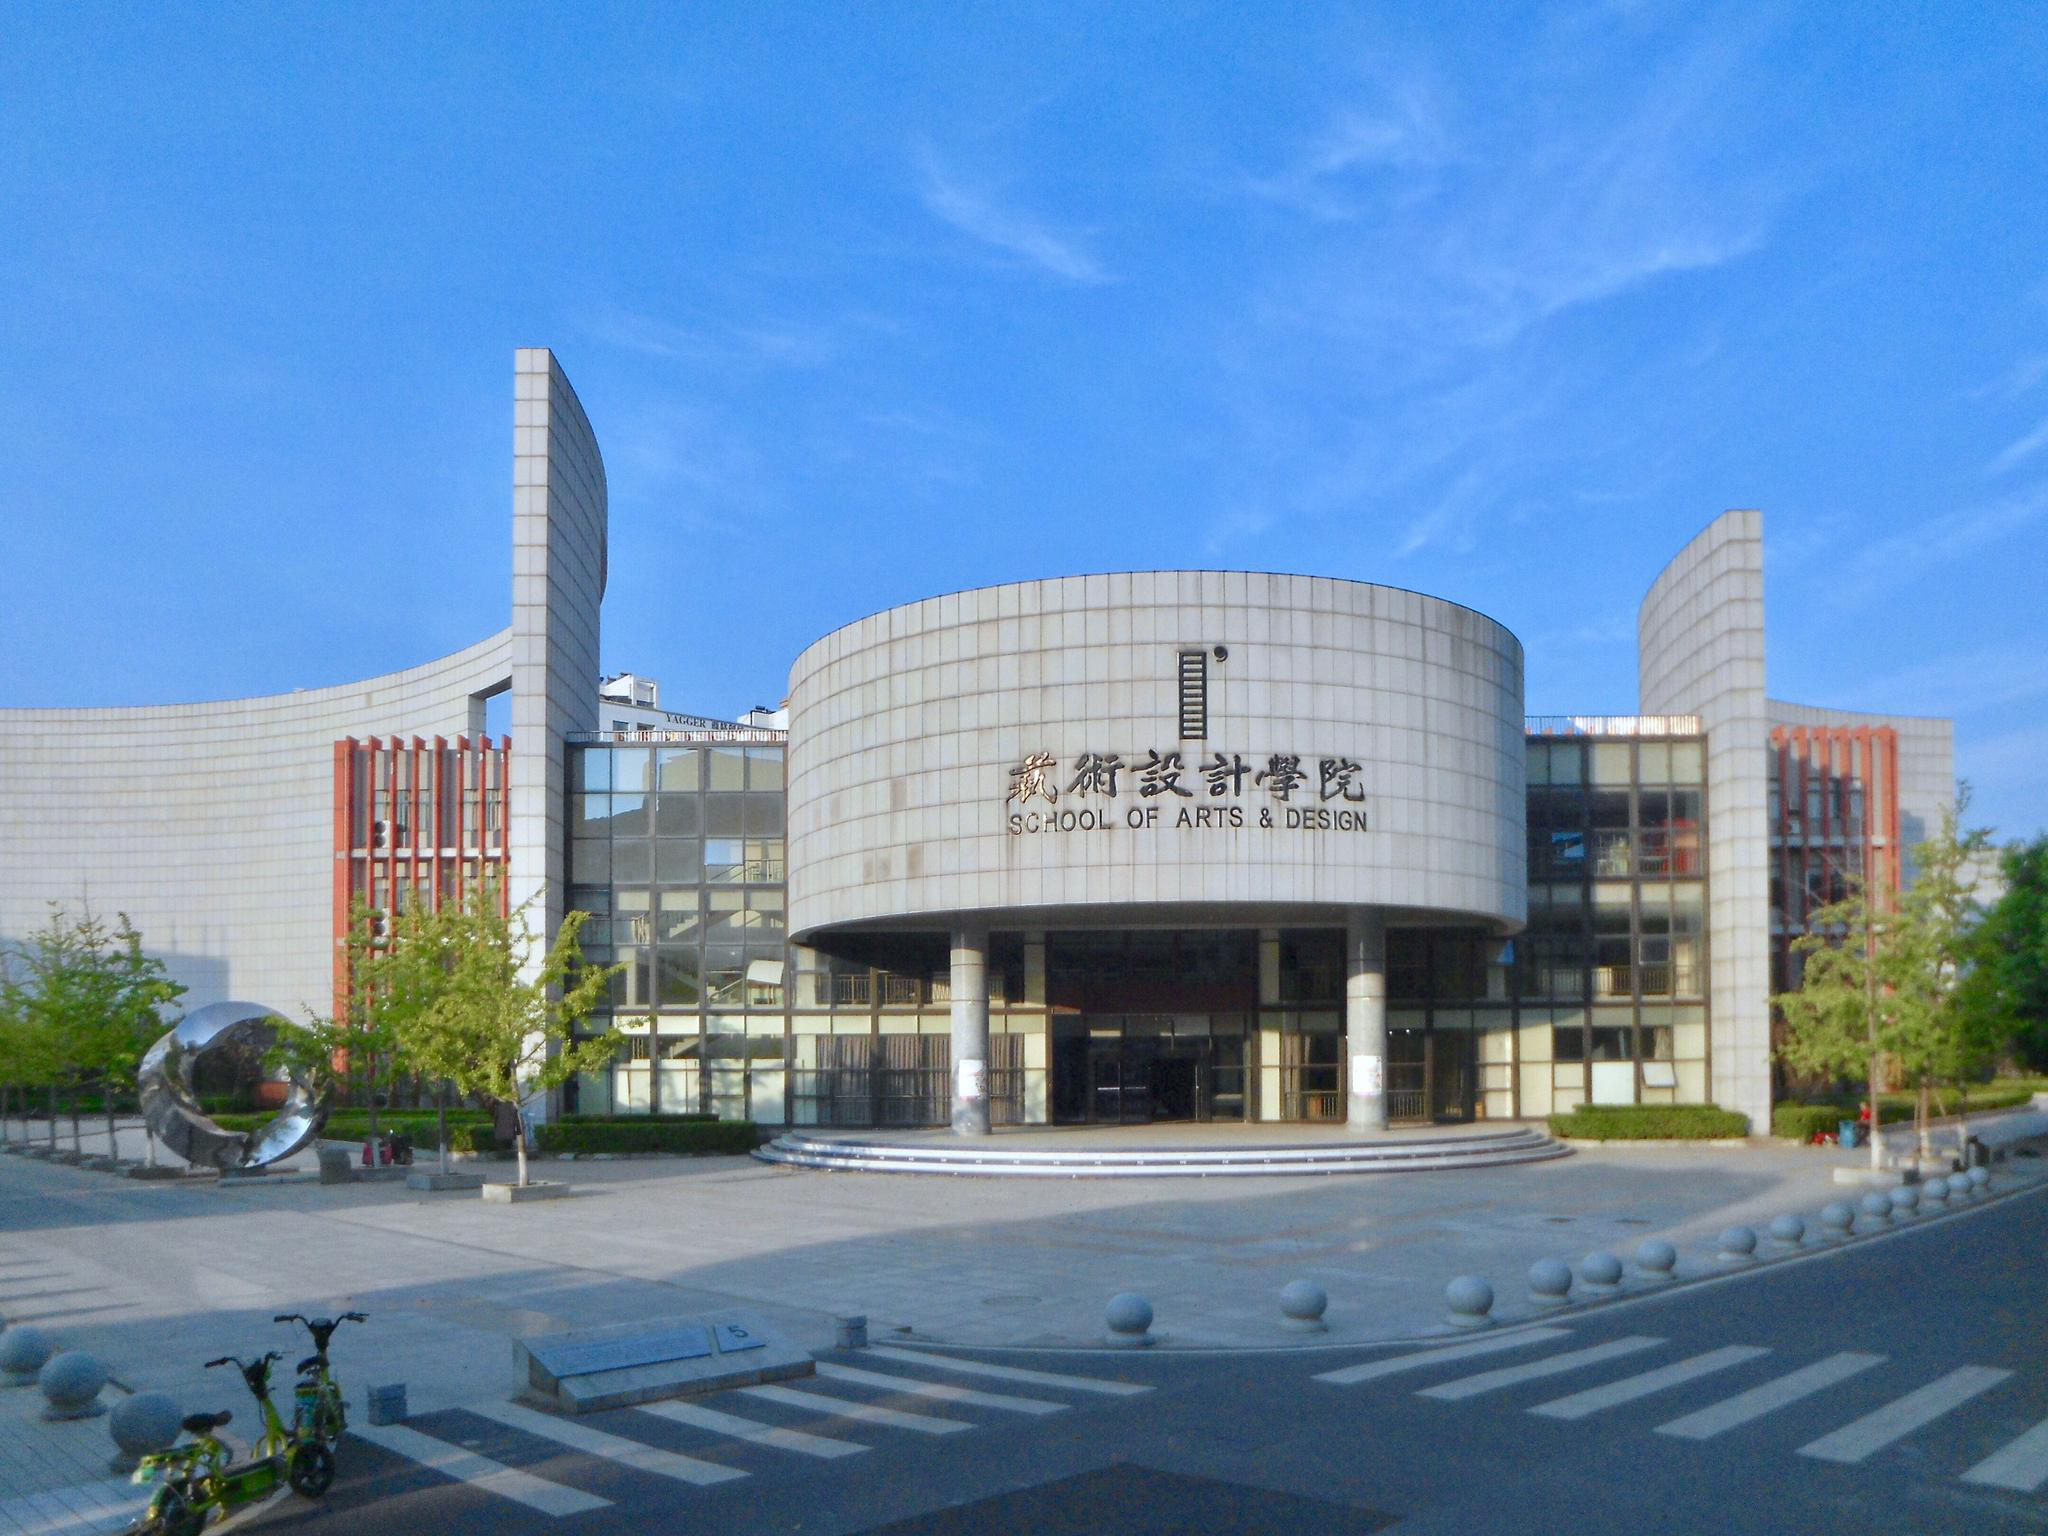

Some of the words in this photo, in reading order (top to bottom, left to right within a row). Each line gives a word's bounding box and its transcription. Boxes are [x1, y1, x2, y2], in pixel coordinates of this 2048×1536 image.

[666, 713, 706, 729] YAGGER
[1009, 809, 1111, 835] SCHOOL
[1127, 807, 1159, 829] OF
[1176, 806, 1243, 828] ARTS
[1260, 808, 1273, 828] &
[1286, 808, 1367, 832] DESIGN
